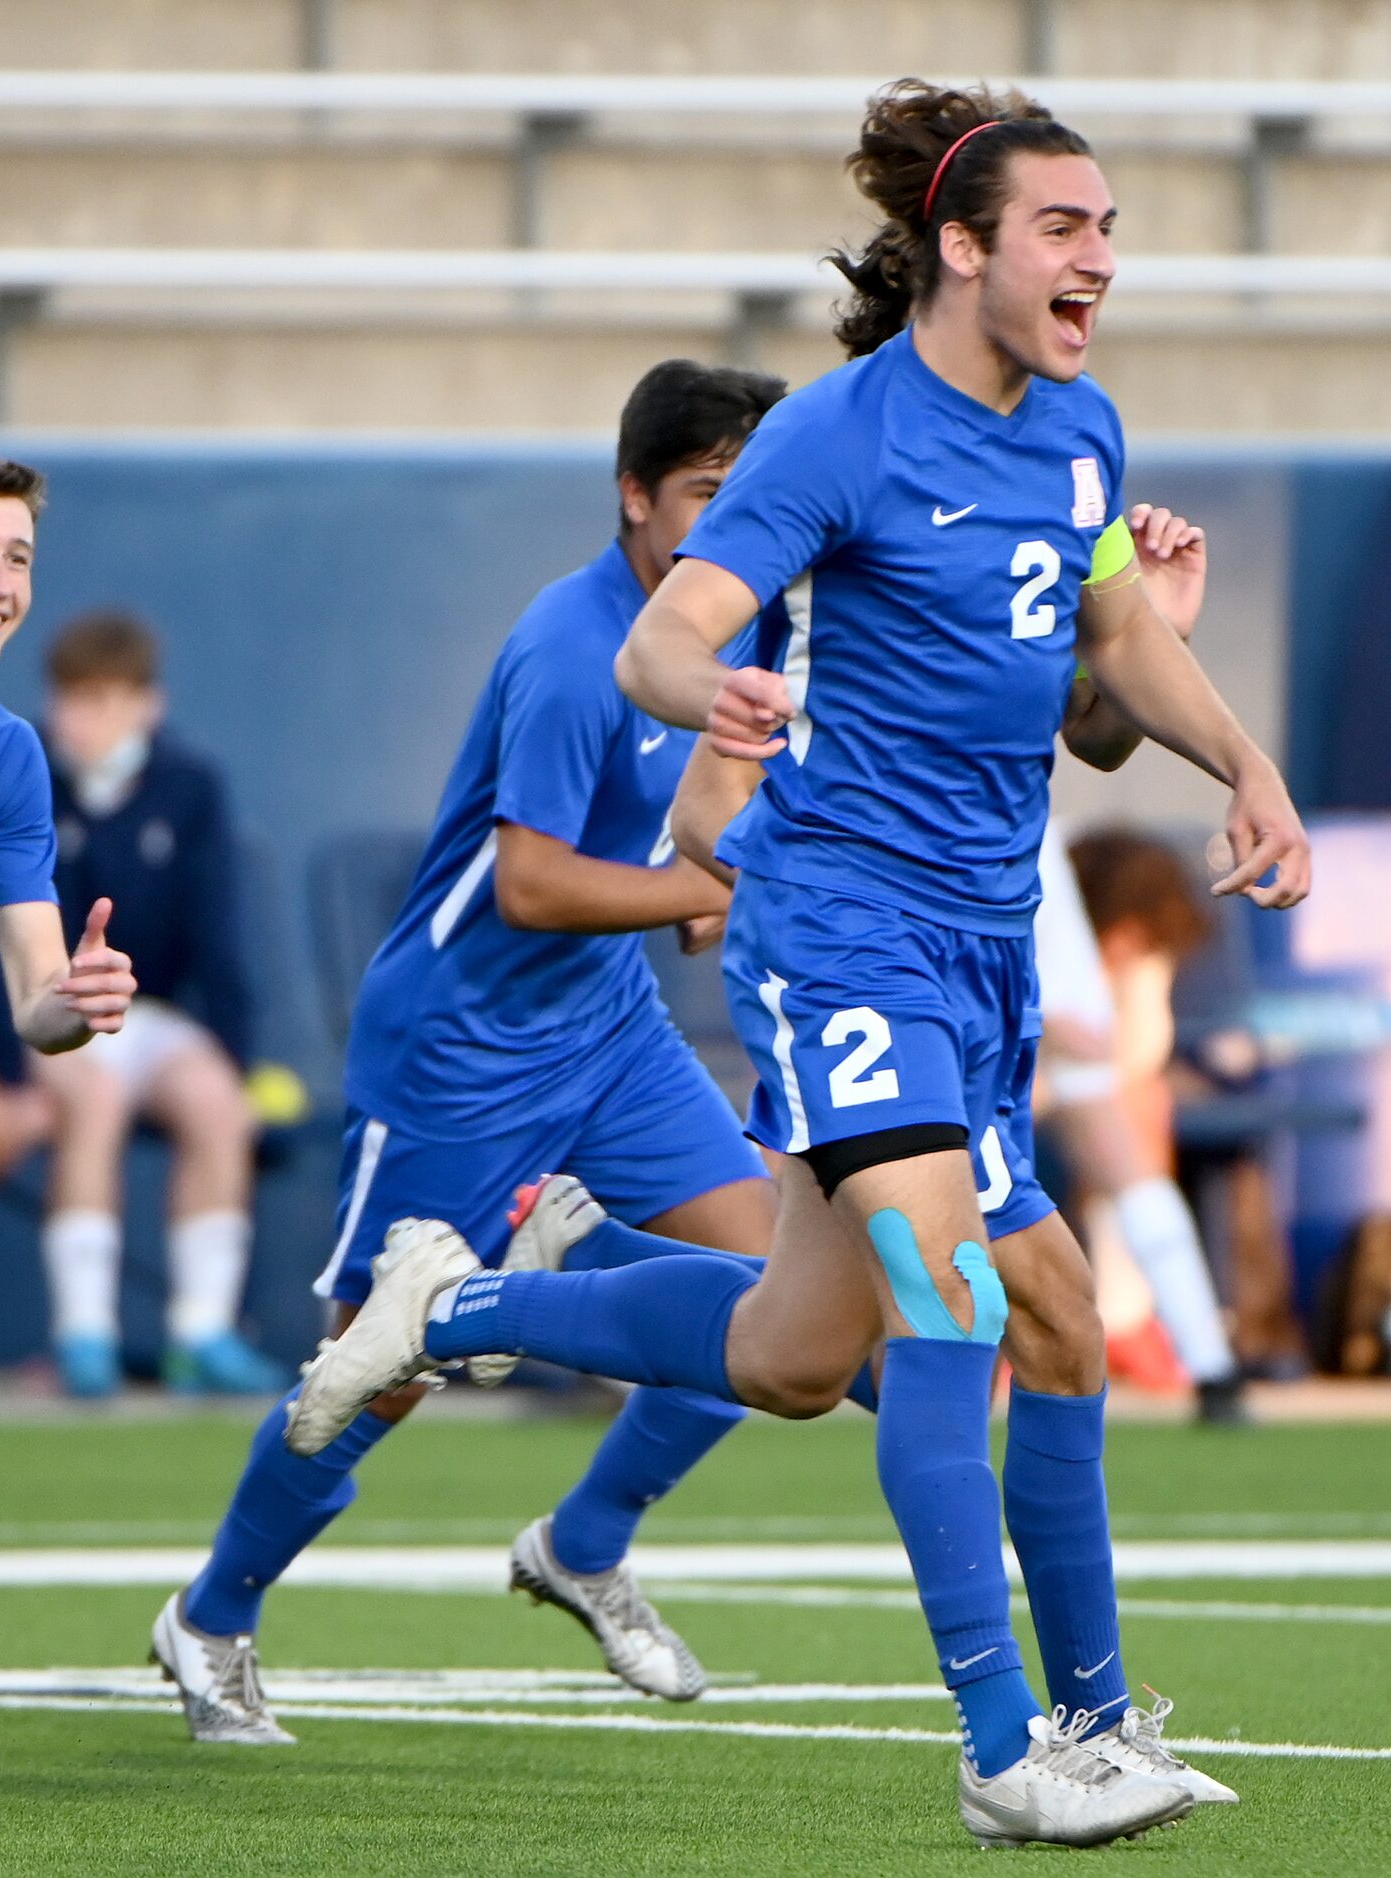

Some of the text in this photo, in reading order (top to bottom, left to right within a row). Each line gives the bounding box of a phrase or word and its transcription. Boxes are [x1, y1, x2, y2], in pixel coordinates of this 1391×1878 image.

[1071, 457, 1107, 529] A
[1010, 540, 1061, 639] 2
[821, 1006, 900, 1109] 2
